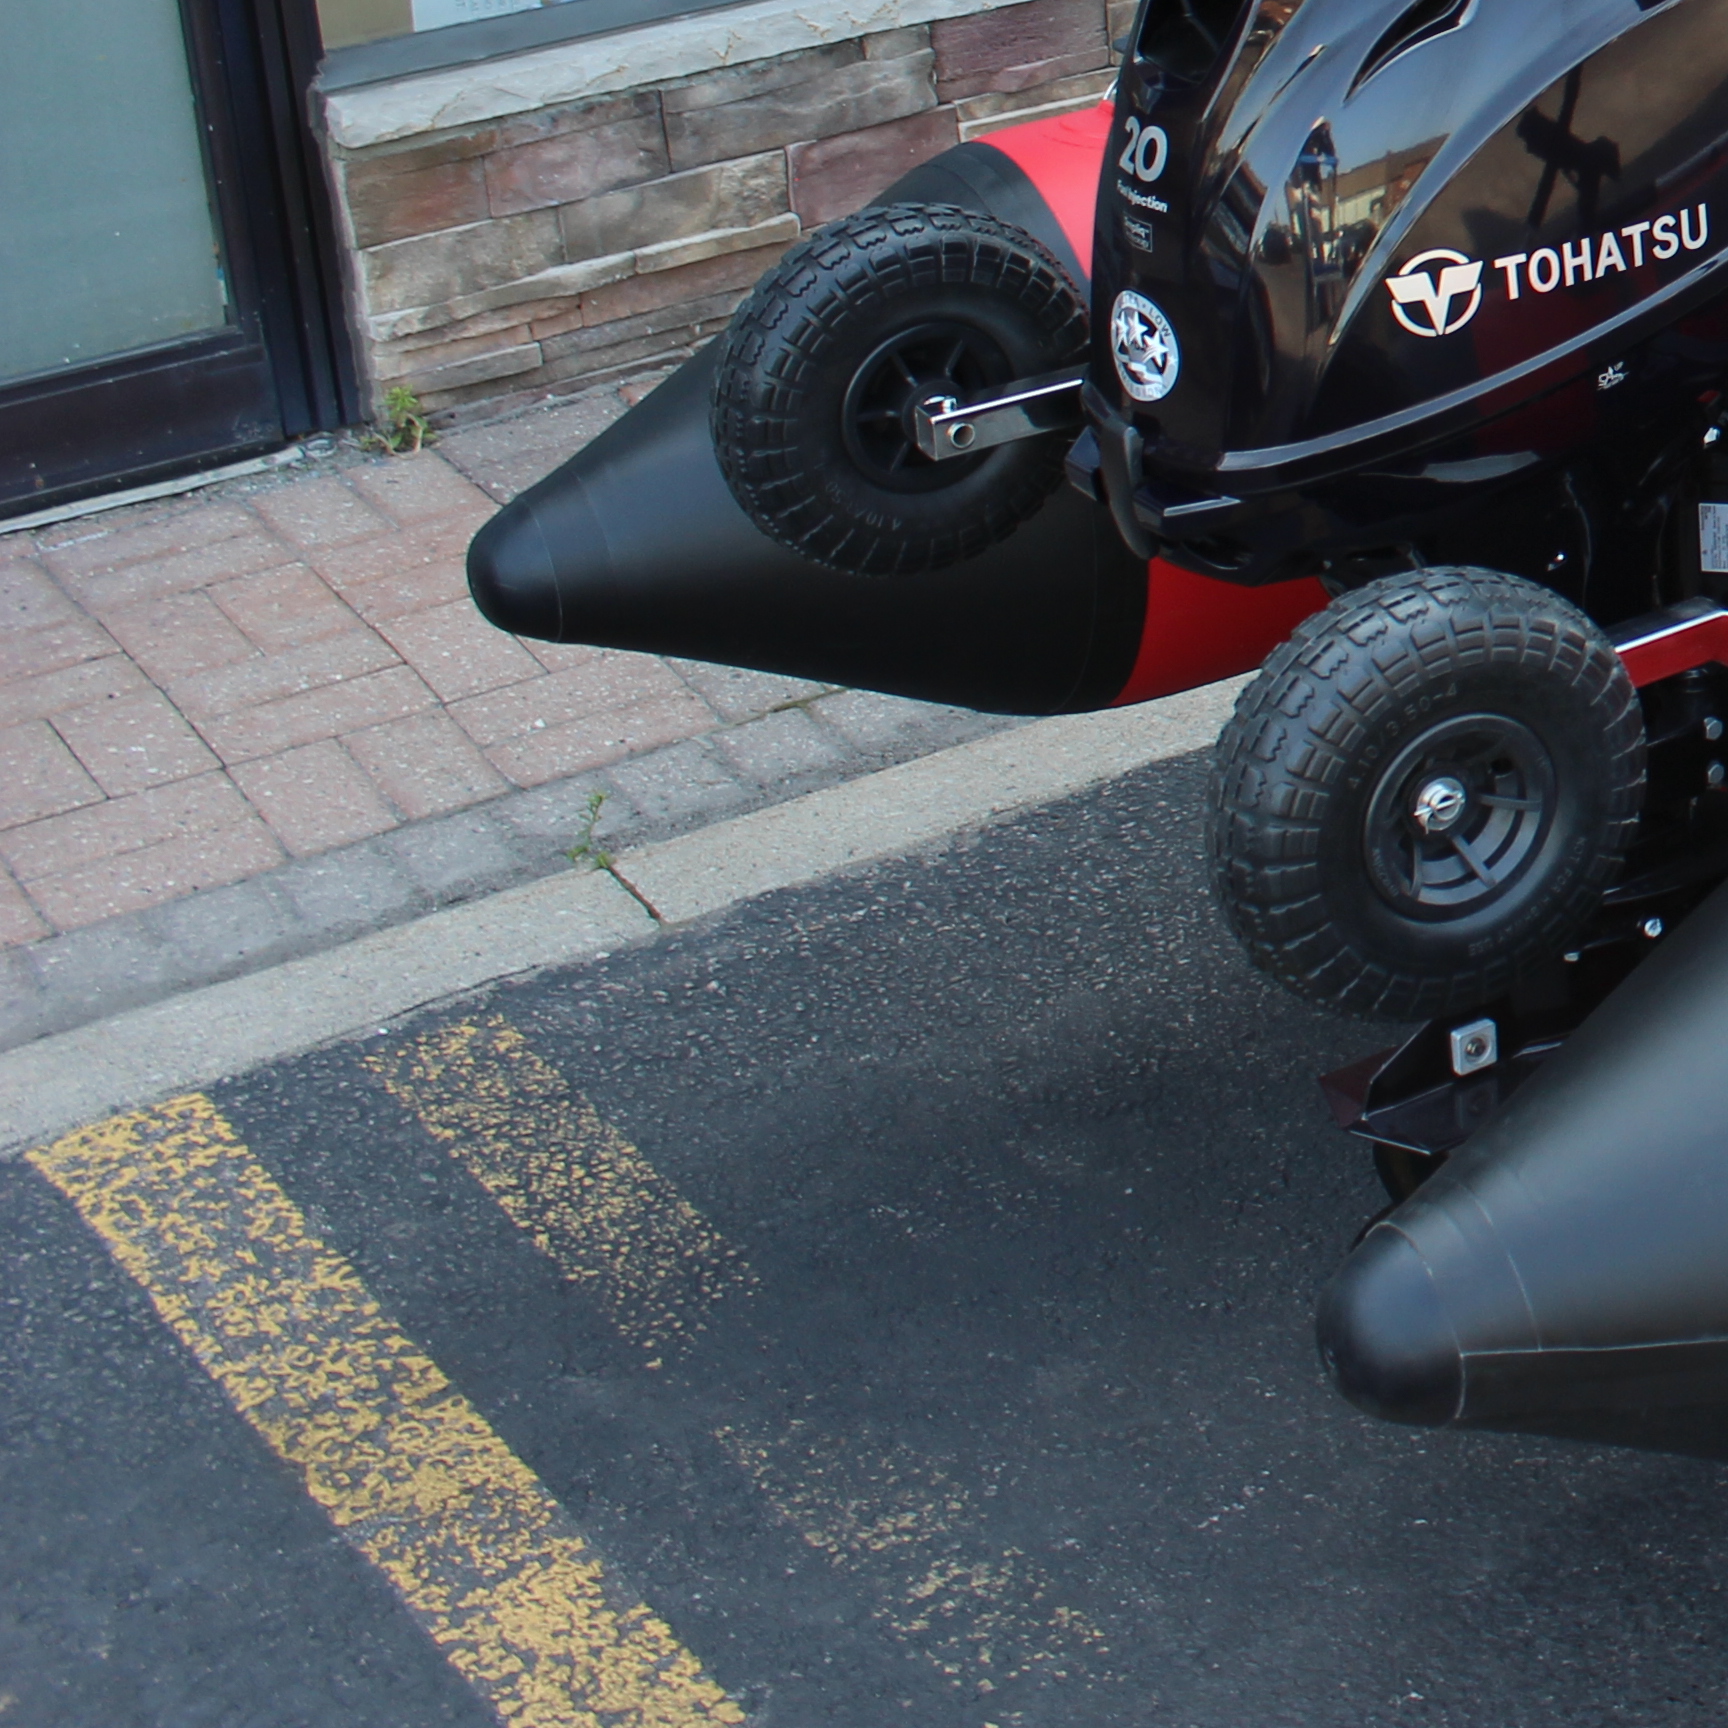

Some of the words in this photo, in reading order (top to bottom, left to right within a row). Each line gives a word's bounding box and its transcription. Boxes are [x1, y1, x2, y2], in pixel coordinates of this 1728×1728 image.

[1119, 115, 1168, 182] 20
[1493, 202, 1709, 301] TOHATSU
[1148, 306, 1172, 338] LOW
